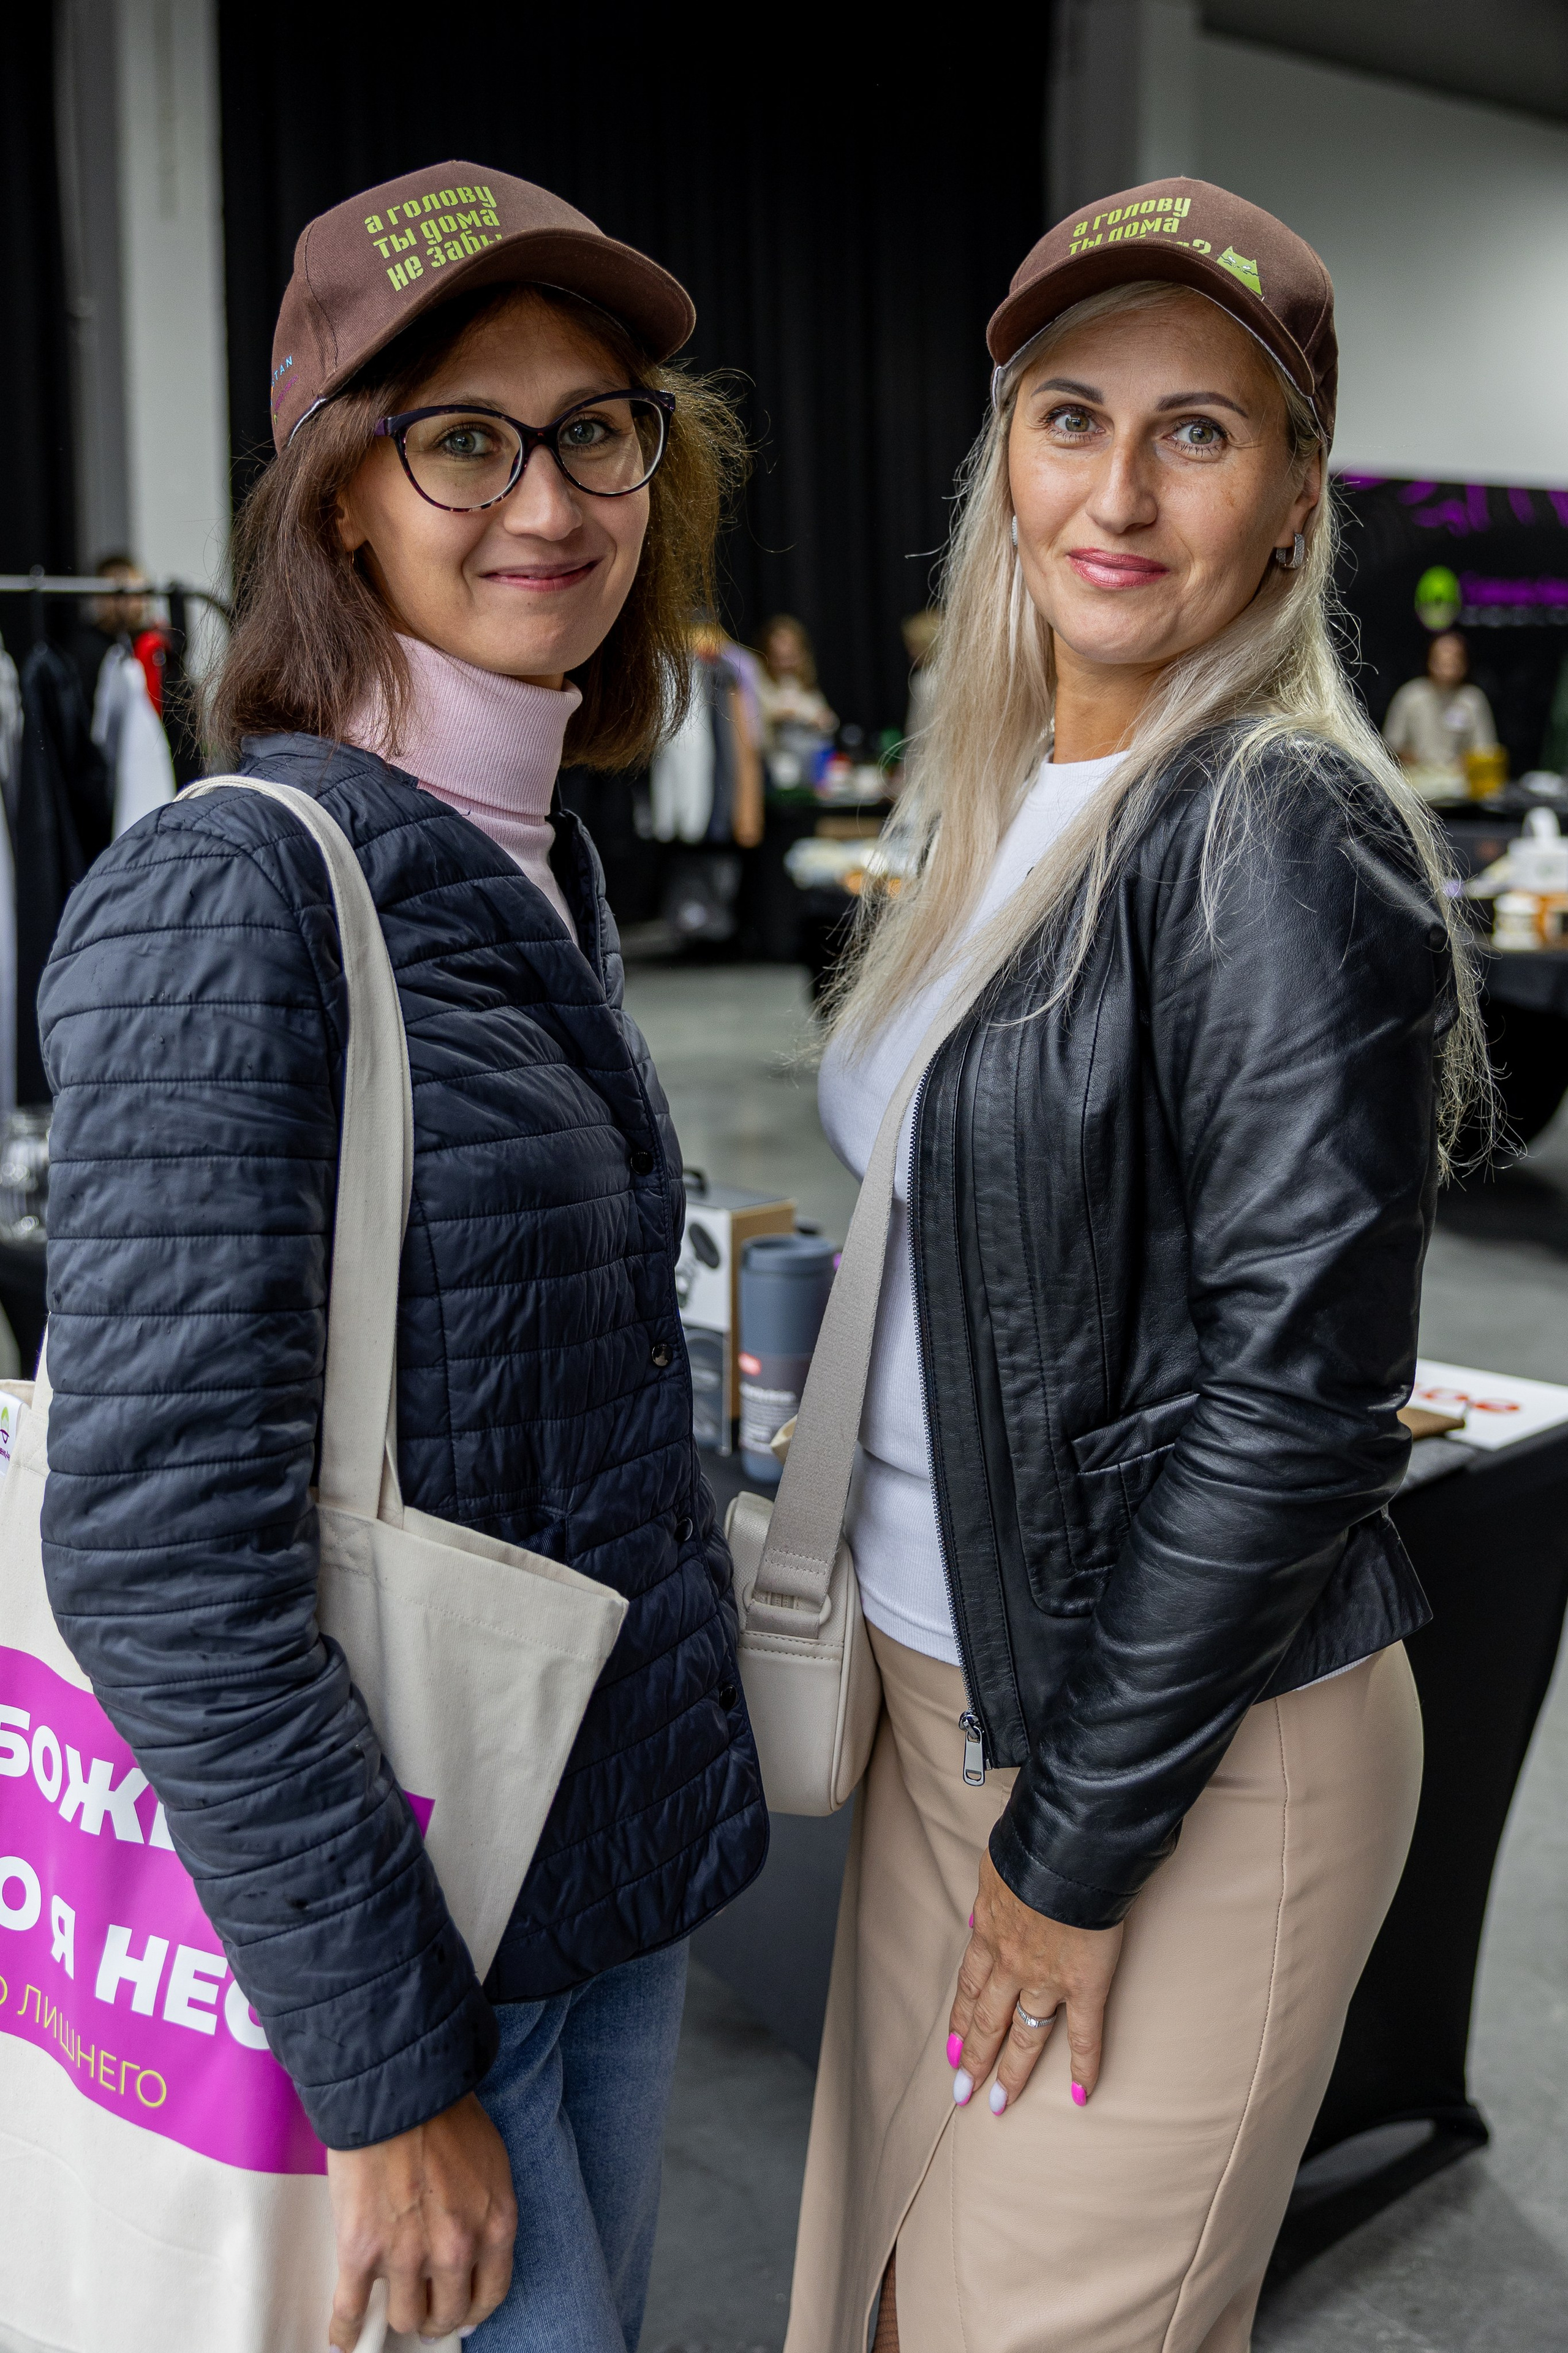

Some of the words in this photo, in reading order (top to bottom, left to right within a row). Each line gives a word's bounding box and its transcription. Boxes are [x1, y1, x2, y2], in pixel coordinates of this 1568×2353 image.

[364, 215, 384, 234] а
[386, 186, 497, 225] голову
[372, 228, 417, 259] ты
[420, 209, 500, 245] дома
[1072, 221, 1088, 237] а
[1092, 197, 1192, 231] голову
[17, 1983, 167, 2107] ЛИШНЕГО
